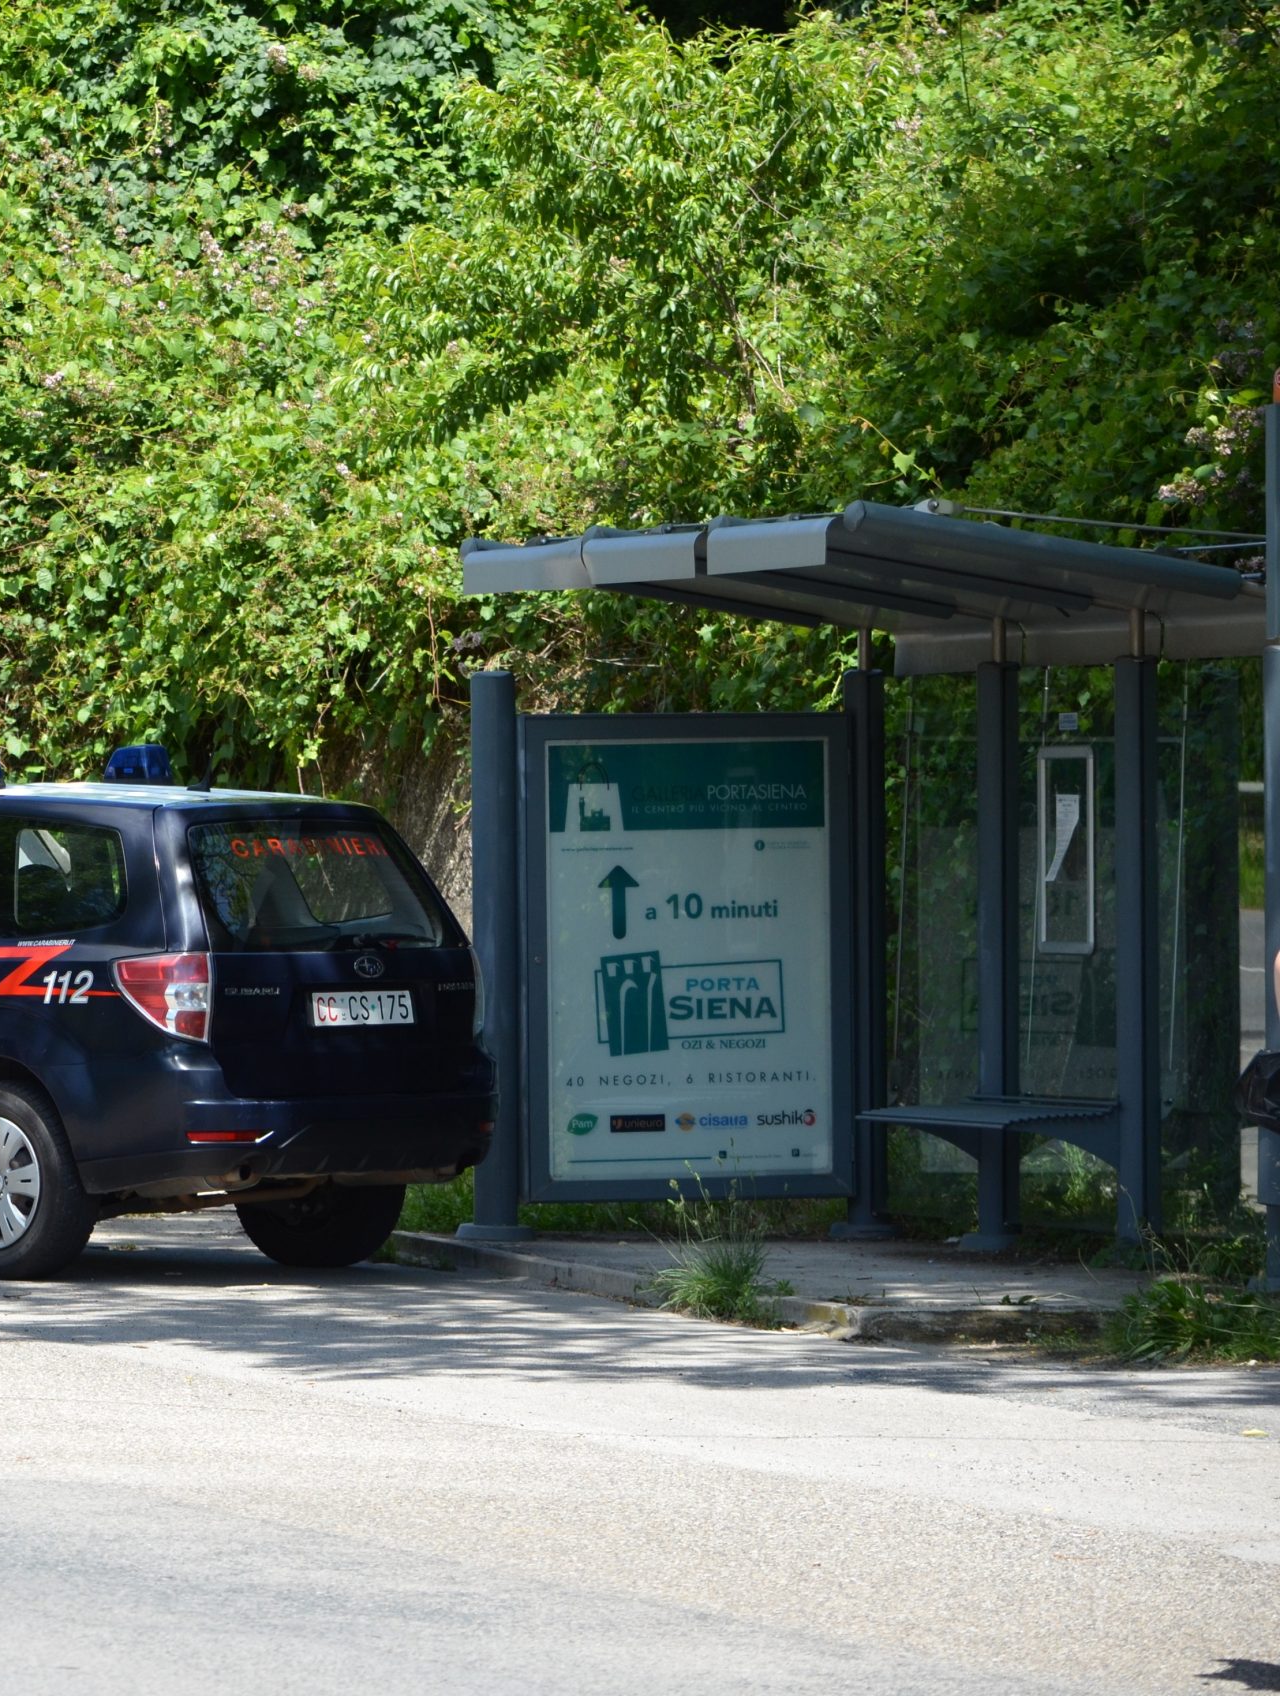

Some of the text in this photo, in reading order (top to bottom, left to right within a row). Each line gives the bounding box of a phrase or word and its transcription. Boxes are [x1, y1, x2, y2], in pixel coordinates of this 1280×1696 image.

[645, 804, 685, 814] CENTRO
[768, 802, 808, 811] CENTRO
[645, 893, 779, 920] a 10 minuti
[43, 970, 95, 1004] 112
[685, 976, 760, 992] PORTA
[317, 994, 409, 1022] CC CS 175
[668, 995, 778, 1021] SIENA
[705, 1038, 715, 1050] &
[719, 1037, 766, 1050] NEGOZI
[566, 1075, 585, 1087] 40
[686, 1072, 694, 1084] 6
[624, 1118, 664, 1130] unieuro
